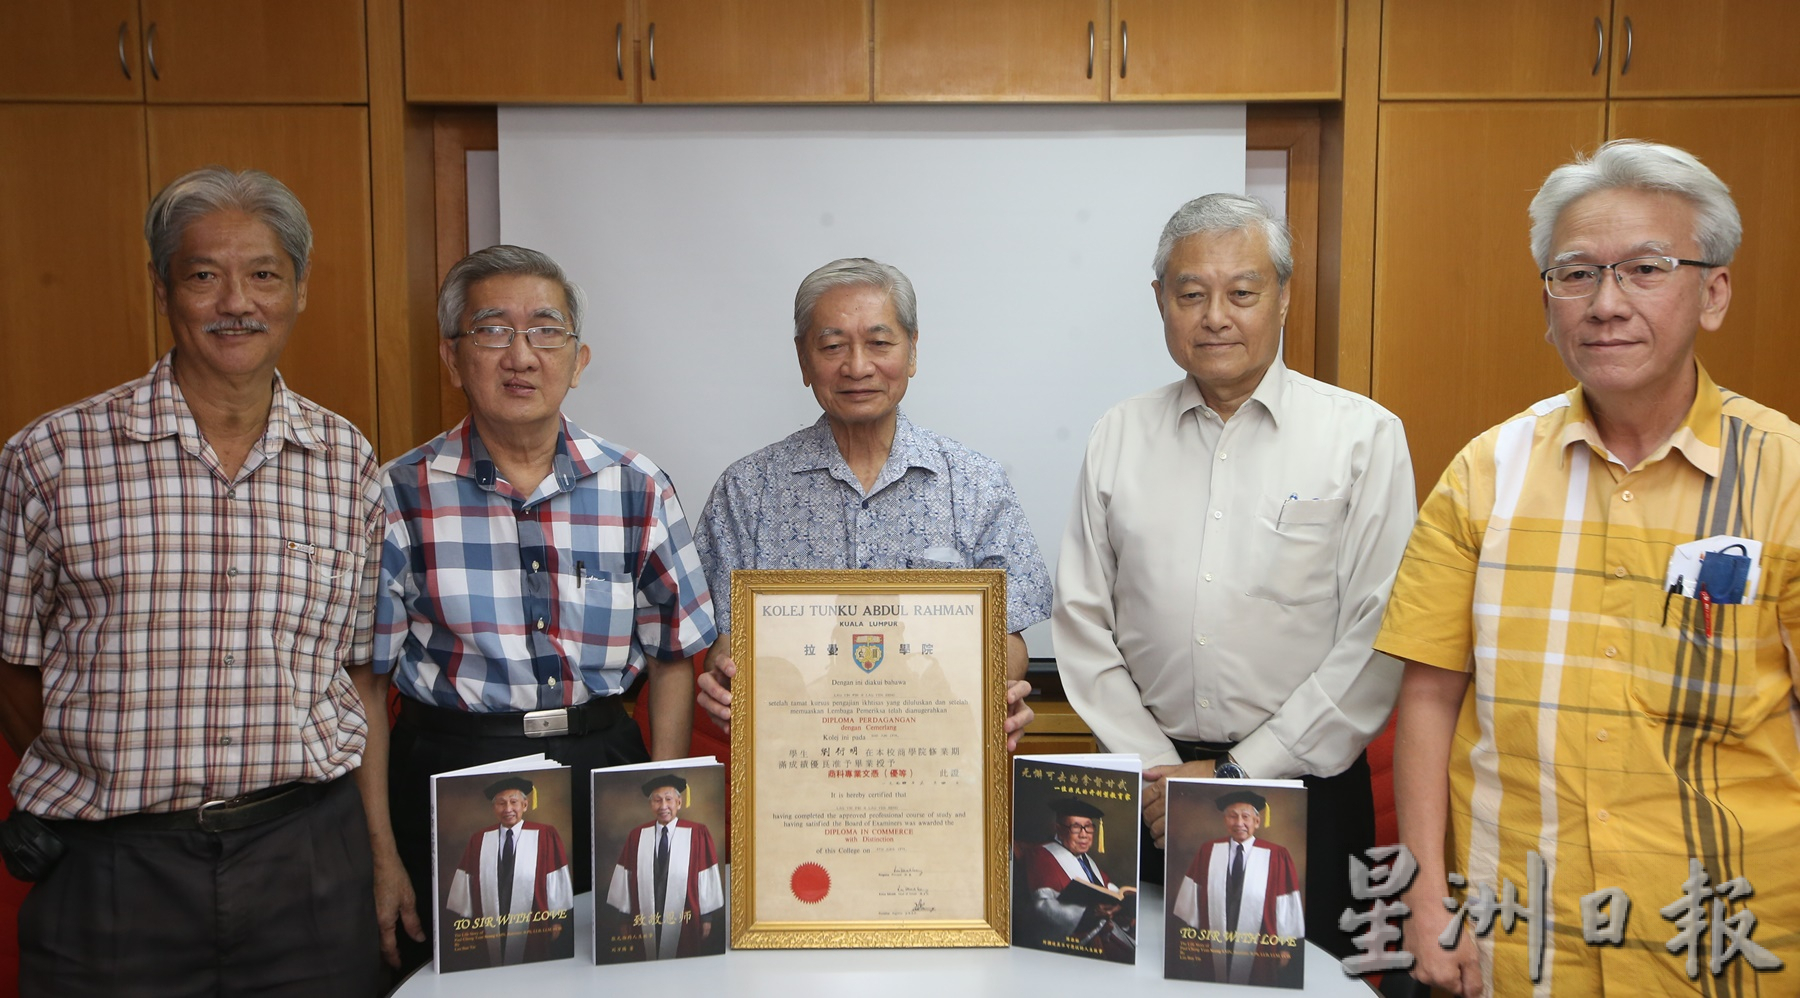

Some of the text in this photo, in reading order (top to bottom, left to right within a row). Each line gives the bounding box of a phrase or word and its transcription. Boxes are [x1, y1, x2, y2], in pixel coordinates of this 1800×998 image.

[763, 605, 974, 616] KOLEJ TUNKU ABDUL RAHMAN
[899, 644, 933, 656] 學院
[789, 750, 808, 758] 學生
[454, 909, 567, 930] TO SIR WITH LOVE
[633, 910, 692, 927] 致敬恩师
[1179, 927, 1297, 947] TO SIR WITH LOVE
